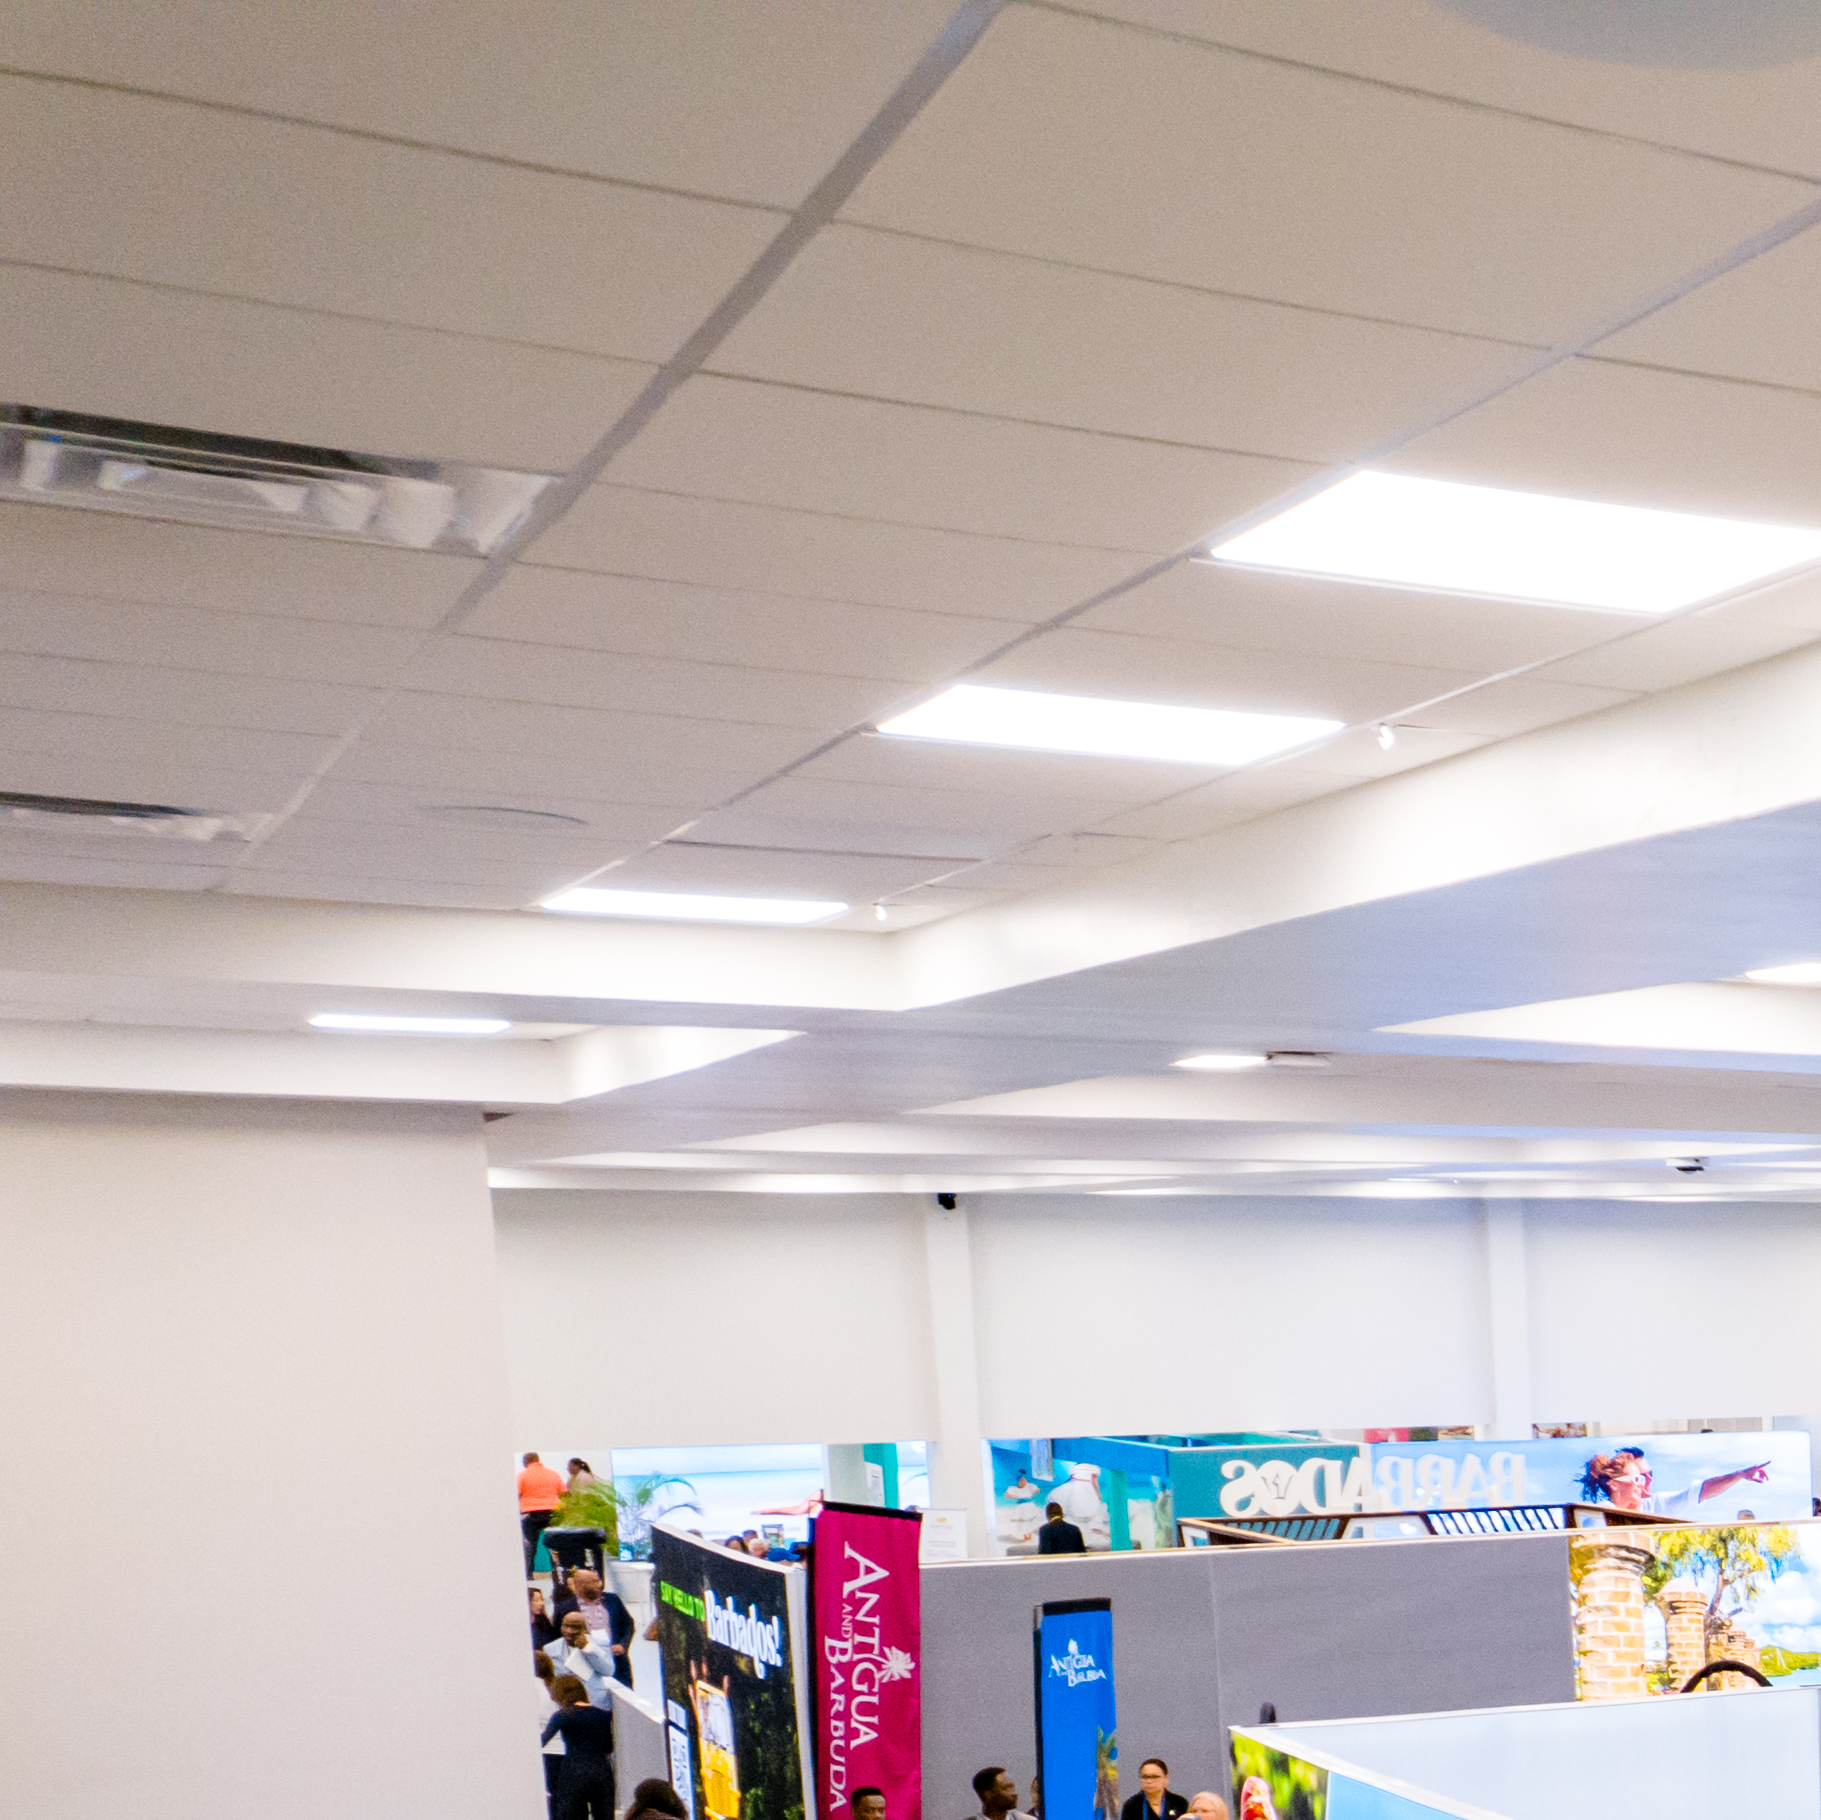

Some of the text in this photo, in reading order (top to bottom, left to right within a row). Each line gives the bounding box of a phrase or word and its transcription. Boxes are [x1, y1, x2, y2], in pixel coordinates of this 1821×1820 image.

[841, 1602, 853, 1639] AND
[842, 1540, 890, 1750] ANTIGUA
[824, 1635, 853, 1812] BARBUDA
